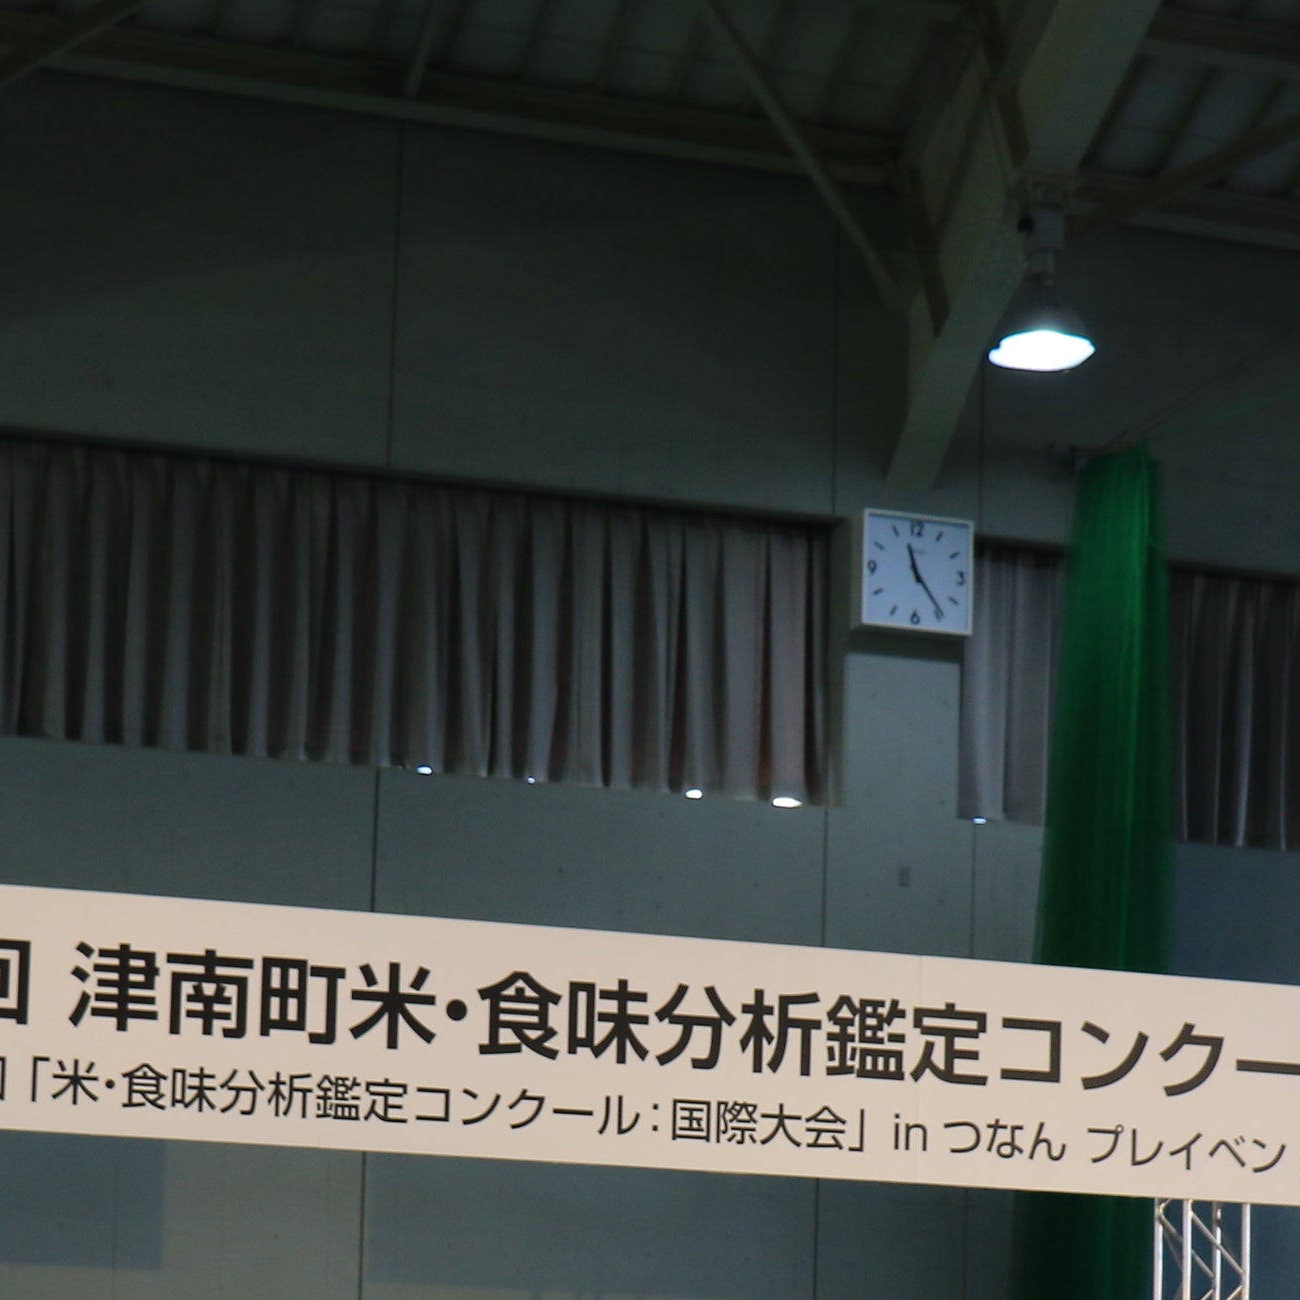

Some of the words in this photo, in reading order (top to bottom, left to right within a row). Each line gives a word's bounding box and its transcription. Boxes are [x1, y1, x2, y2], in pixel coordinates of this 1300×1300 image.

[910, 520, 925, 537] 12
[909, 608, 921, 625] 6
[893, 1112, 928, 1152] in
[943, 1118, 1066, 1162] つなん
